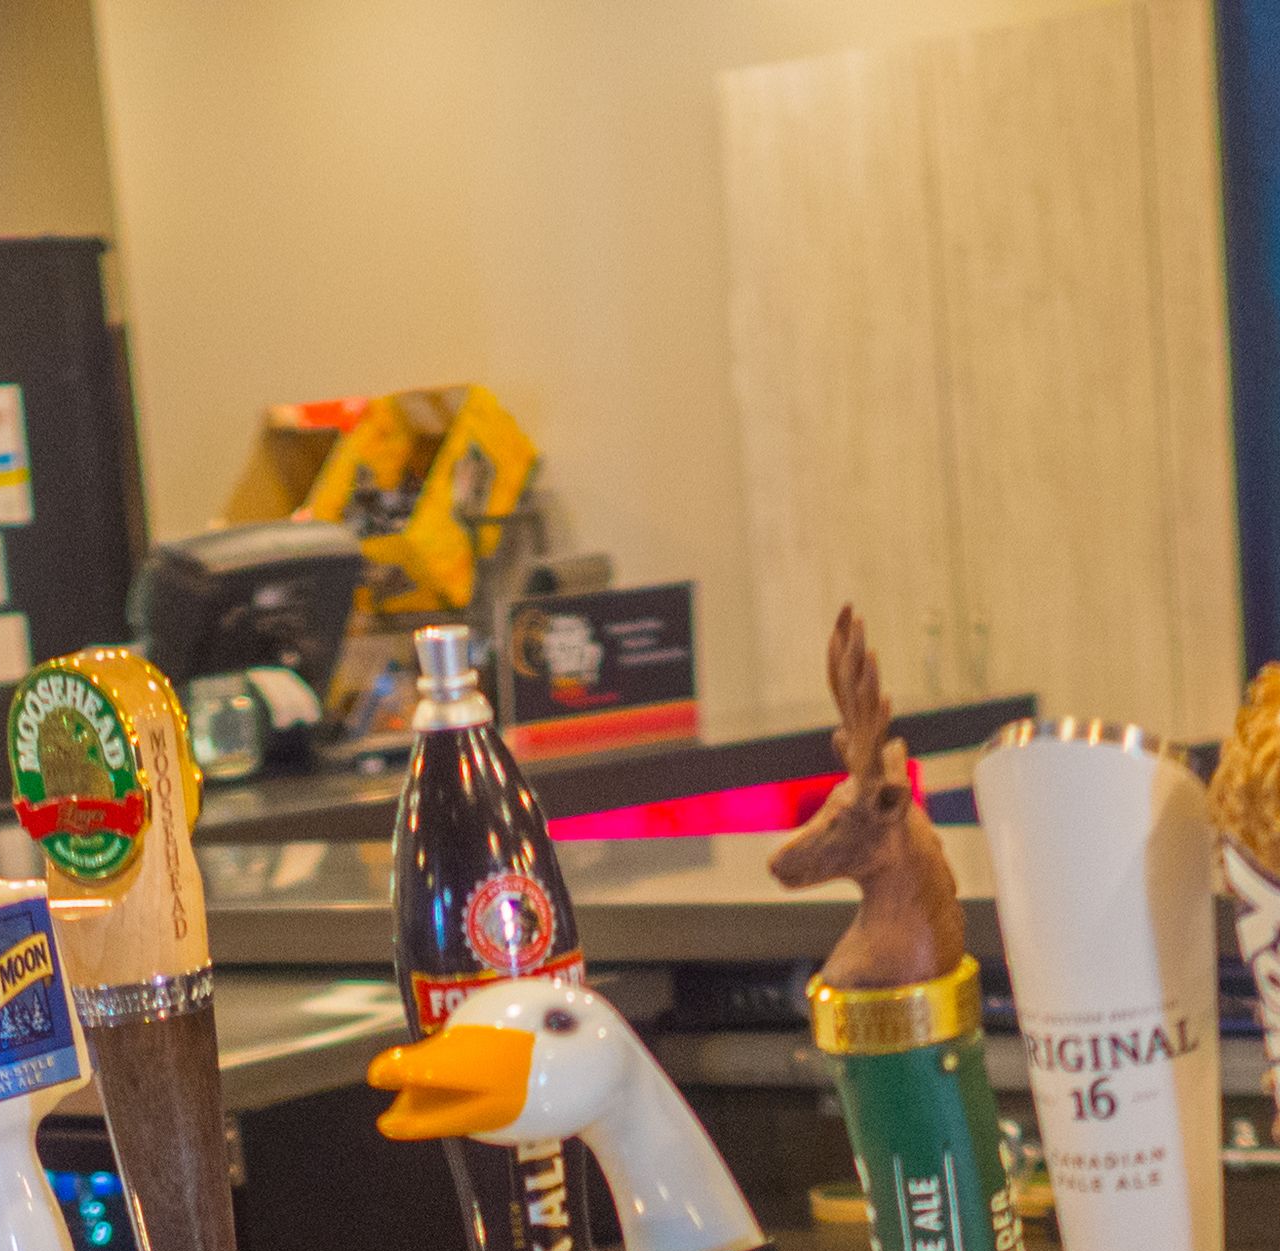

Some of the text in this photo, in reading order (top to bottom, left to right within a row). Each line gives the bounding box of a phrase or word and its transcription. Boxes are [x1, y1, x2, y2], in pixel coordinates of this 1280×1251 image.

[18, 674, 126, 771] MOOSEHEAD
[150, 728, 187, 939] MOOSEHEAD
[18, 1072, 43, 1093] ALE
[1071, 1076, 1118, 1121] 16
[908, 1174, 946, 1233] ALE
